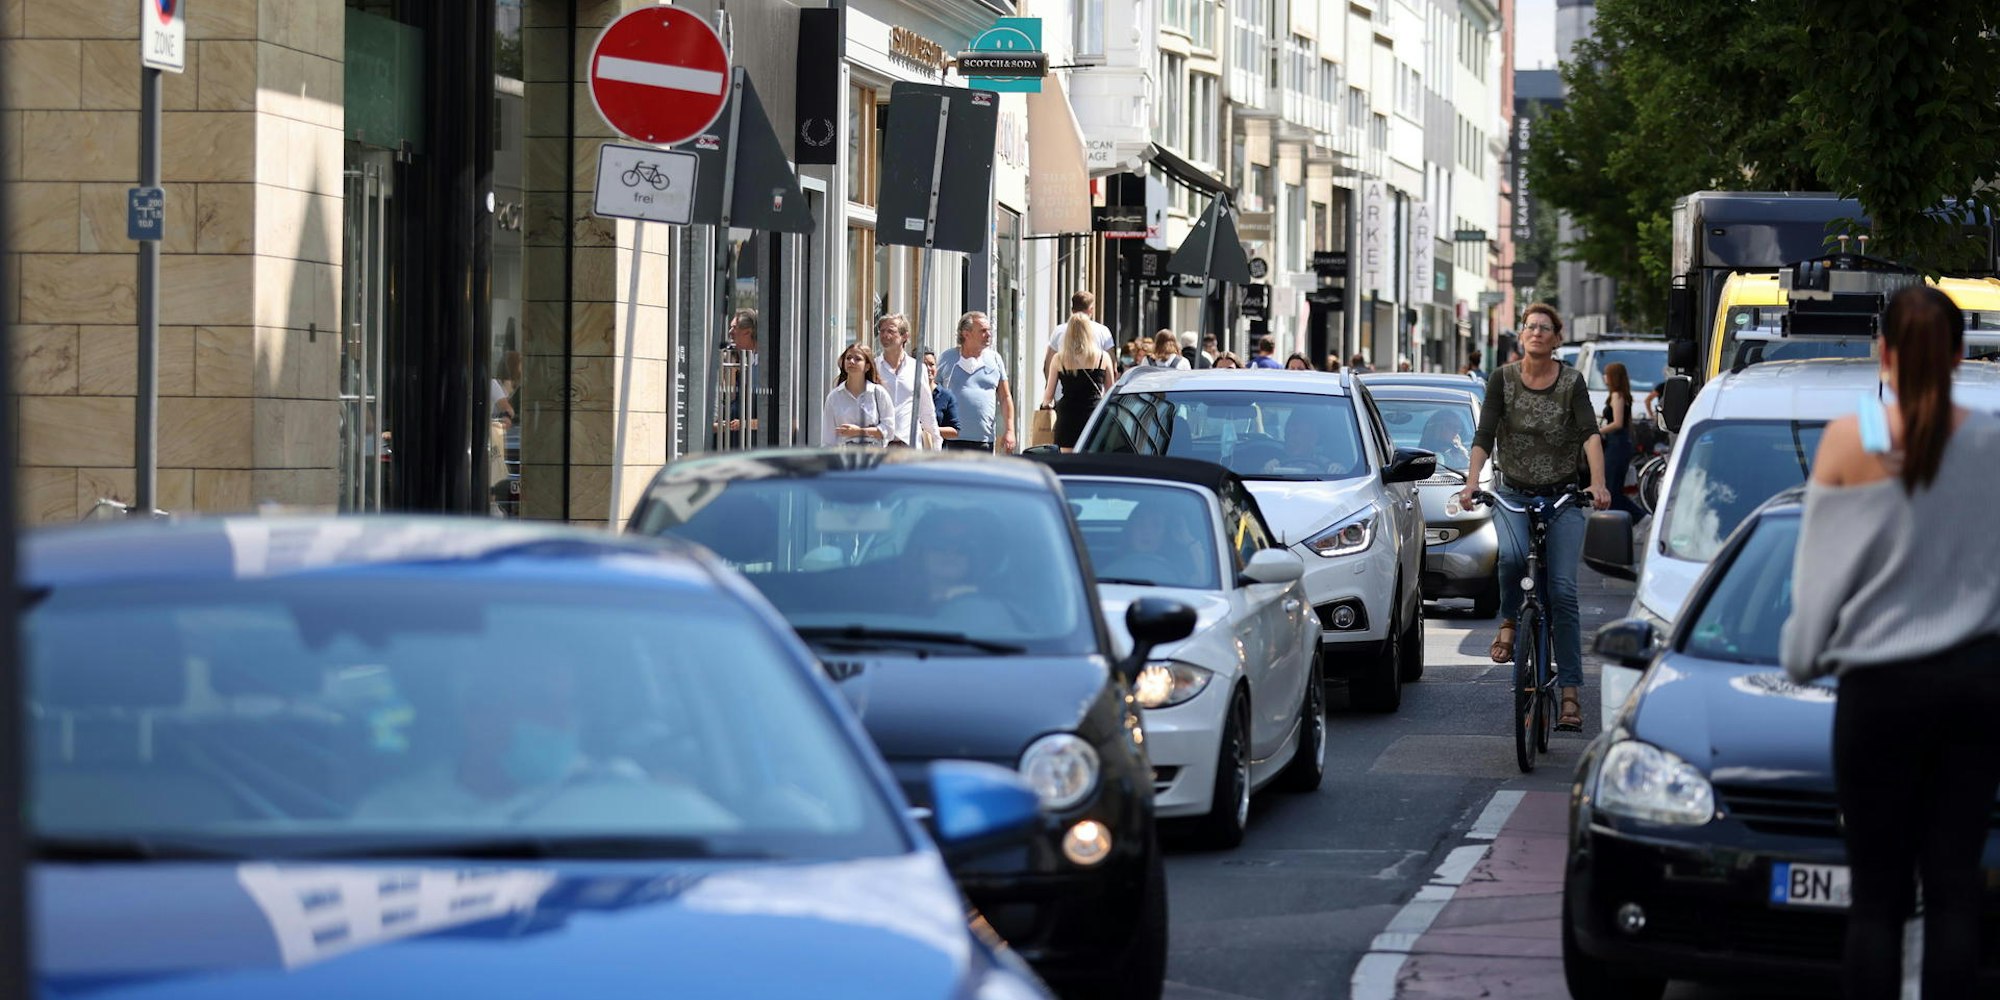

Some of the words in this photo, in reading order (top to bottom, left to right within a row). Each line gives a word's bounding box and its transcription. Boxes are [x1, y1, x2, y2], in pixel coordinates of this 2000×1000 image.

[154, 31, 175, 57] ZONE
[963, 59, 1038, 69] SCOTCH&SODA
[1518, 117, 1530, 150] SON
[634, 191, 654, 204] frei
[1366, 183, 1381, 286] ARKET
[1416, 205, 1429, 300] ARKET
[1180, 274, 1204, 284] ONL
[1790, 868, 1832, 901] BN
